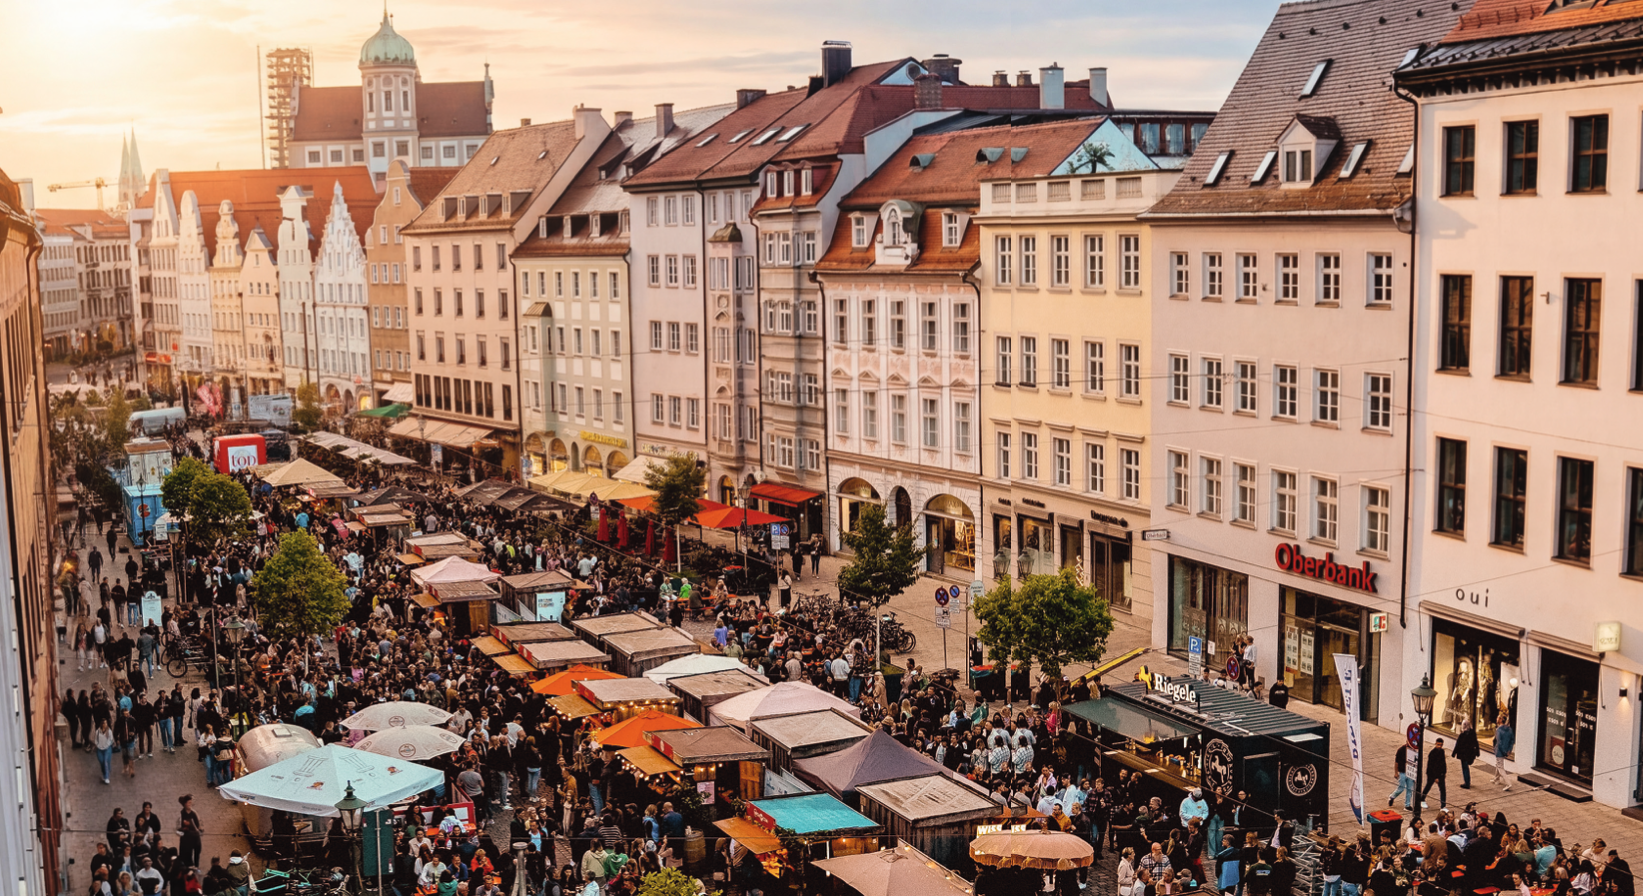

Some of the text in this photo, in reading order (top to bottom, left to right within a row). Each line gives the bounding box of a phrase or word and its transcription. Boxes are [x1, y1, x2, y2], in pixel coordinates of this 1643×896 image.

[1275, 542, 1378, 593] Oberbank
[1456, 588, 1489, 607] oui
[1190, 638, 1198, 650] P
[1154, 673, 1197, 703] Riegele
